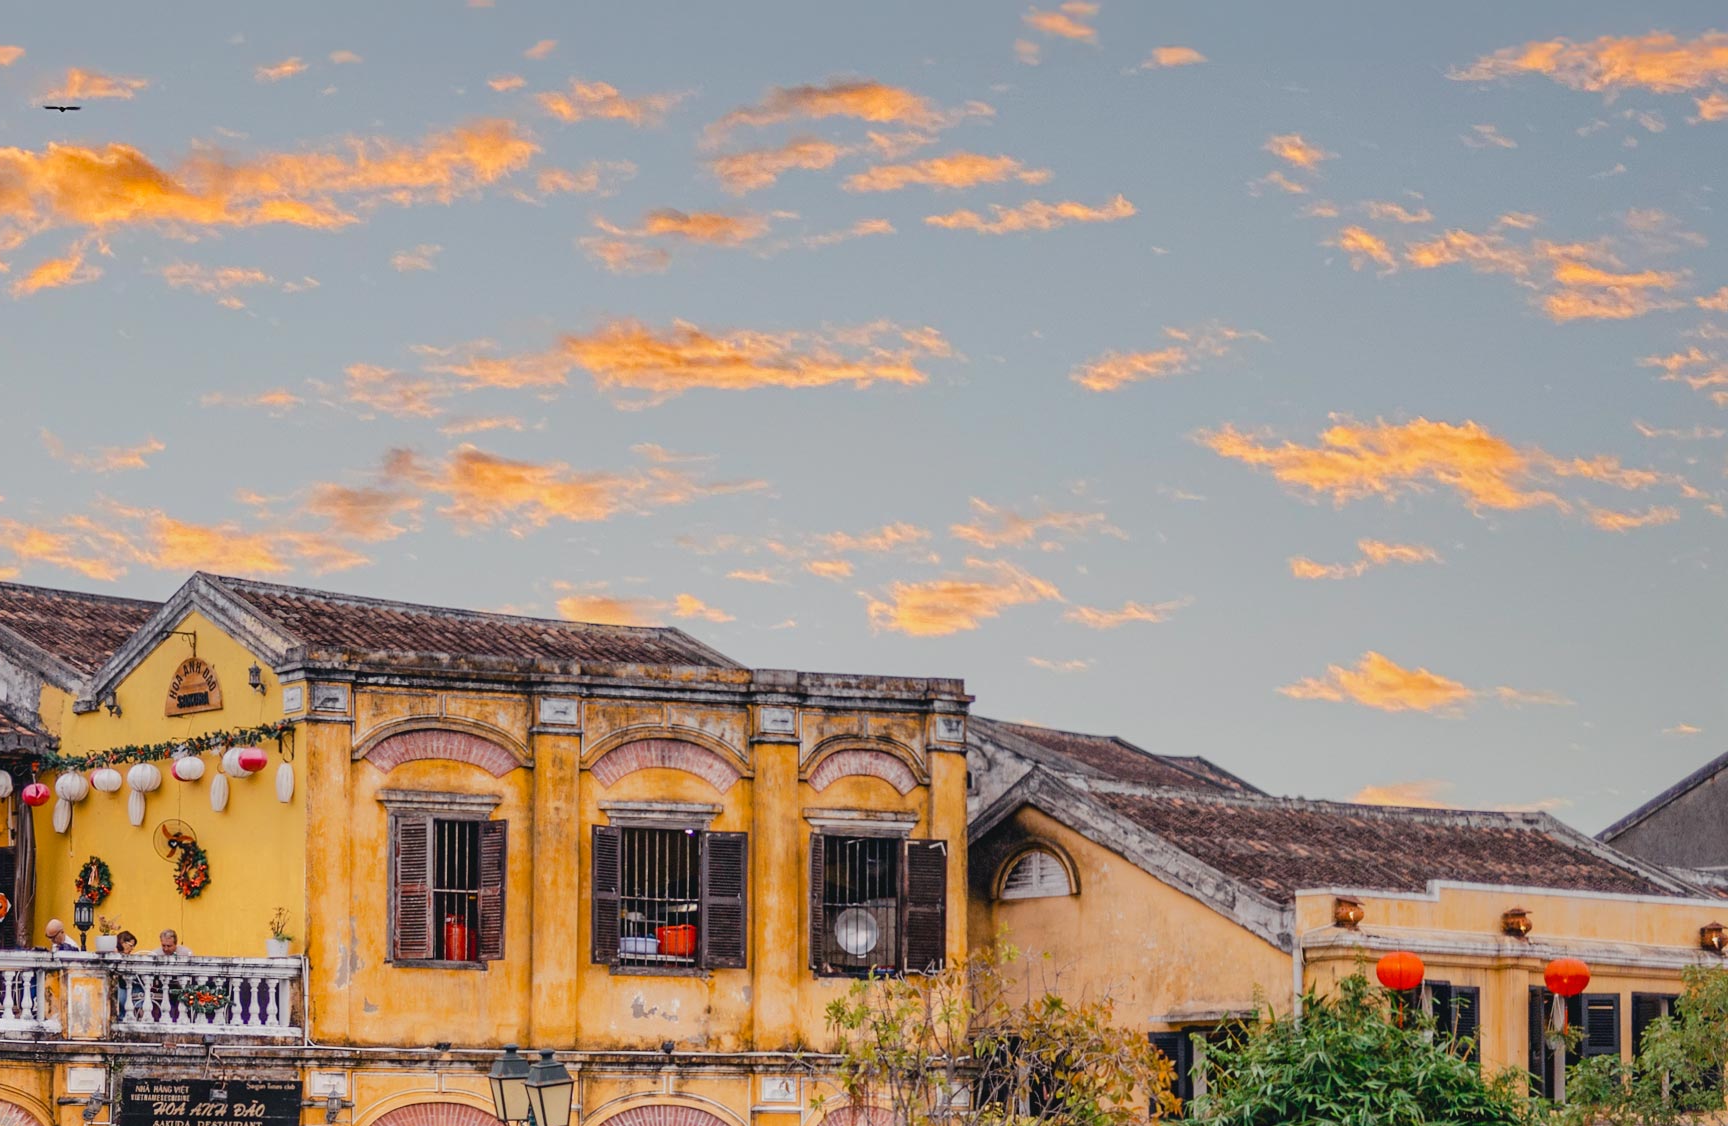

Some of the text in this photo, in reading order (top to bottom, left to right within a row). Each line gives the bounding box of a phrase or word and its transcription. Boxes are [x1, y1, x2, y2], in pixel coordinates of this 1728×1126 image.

[169, 673, 183, 700] HOA
[183, 660, 202, 677] ANH
[152, 1101, 187, 1116] HOA
[189, 1102, 229, 1117] ANH
